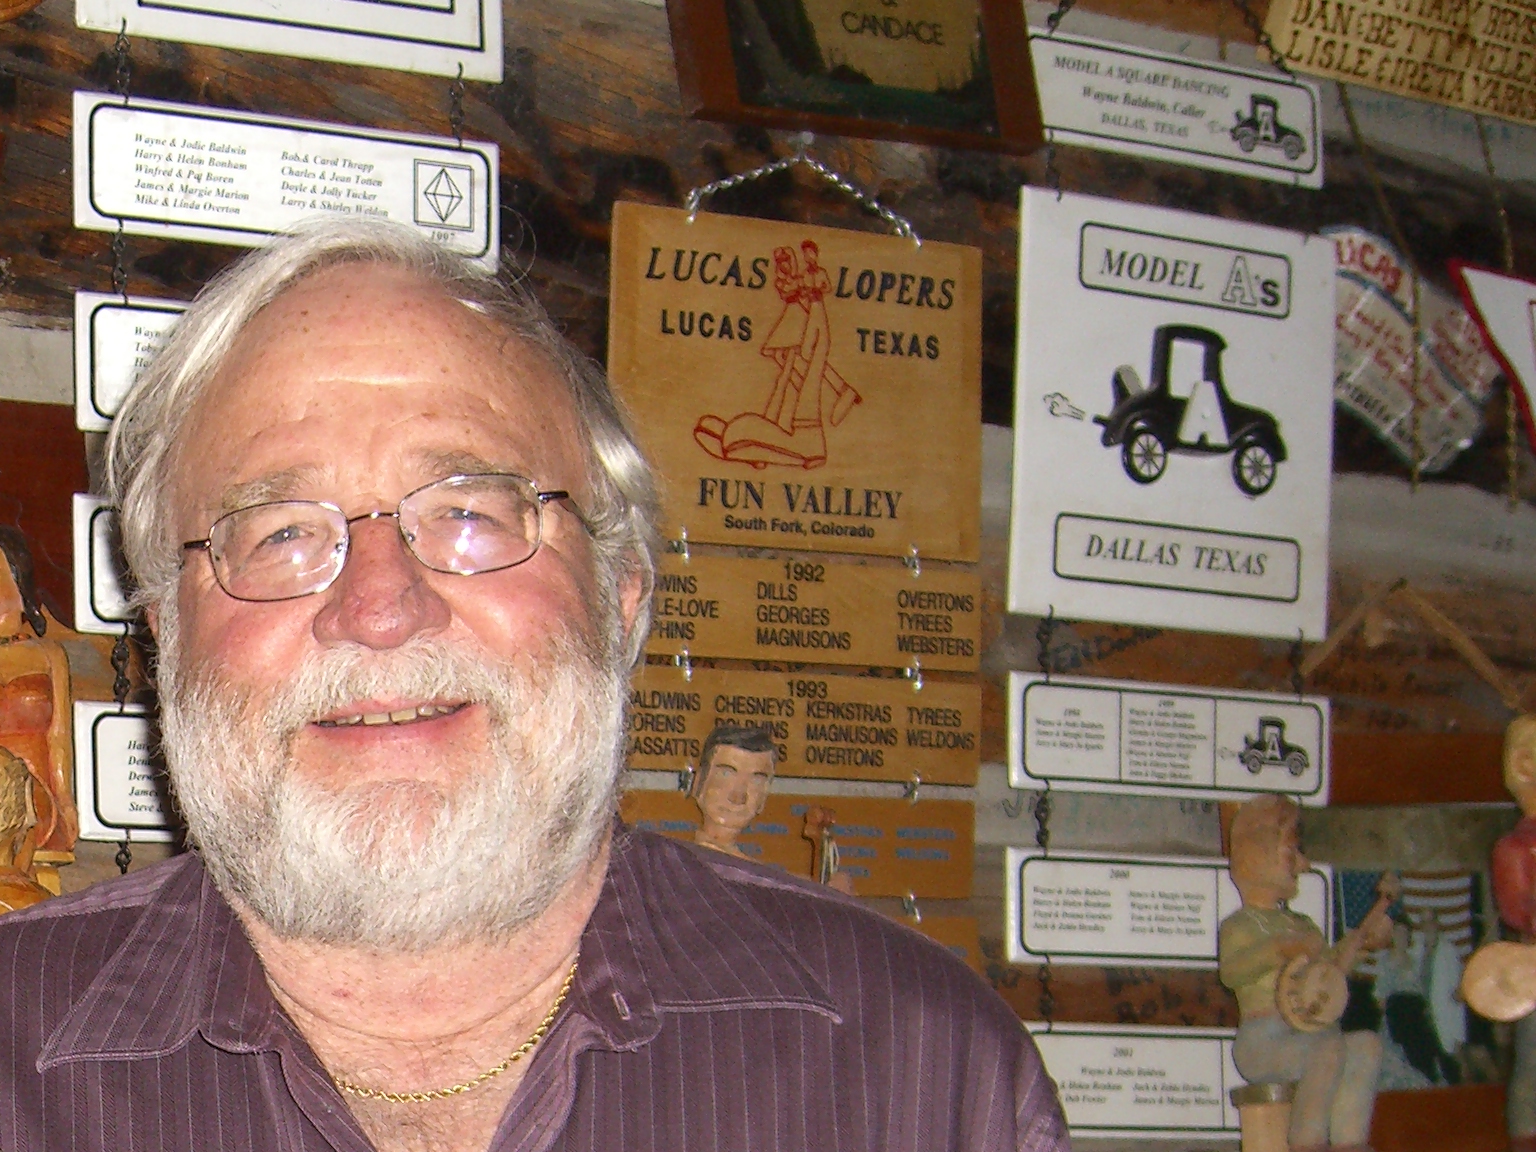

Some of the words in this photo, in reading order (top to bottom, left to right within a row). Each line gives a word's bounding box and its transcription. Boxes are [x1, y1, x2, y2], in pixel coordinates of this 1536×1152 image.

[841, 11, 944, 46] CANDACE
[1054, 55, 1100, 74] MODEL
[1106, 65, 1114, 77] A
[1118, 67, 1170, 87] SQUARE
[135, 134, 166, 145] Wayne
[209, 143, 246, 155] Baldwin
[135, 149, 161, 162] Harry
[177, 154, 204, 165] Helen
[209, 157, 247, 170] Bonham
[136, 164, 173, 177] Winfred
[135, 179, 164, 190] James
[137, 194, 158, 205] Mike
[173, 199, 200, 210] Linda
[646, 247, 770, 290] LUCAS
[835, 266, 956, 311] LOPERS
[1100, 247, 1205, 291] MODEL
[661, 309, 753, 342] LUCAS
[857, 328, 940, 360] TEXAS
[698, 477, 764, 510] FUN
[782, 483, 903, 520] VALLEY
[725, 514, 767, 531] South
[772, 517, 807, 537] Fork,
[811, 521, 875, 539] Colorado
[1085, 533, 1181, 568] DALLAS
[1192, 545, 1267, 577] TEXAS
[785, 562, 825, 583] 1992
[657, 574, 697, 594] WINS
[757, 581, 797, 601] DILLS
[655, 597, 719, 619] LE-LOVE
[898, 590, 975, 612] OVERTONS
[757, 605, 830, 626] GEORGES
[897, 613, 953, 633] TYREES
[757, 628, 851, 650] MAGNUSONS
[897, 634, 975, 656] WEBSTERS
[787, 680, 828, 700] 1993
[716, 695, 795, 717] CHESNEYS
[806, 700, 892, 723] KERKSTRAS
[906, 706, 962, 728] TYREES
[806, 724, 898, 747] MAGNUSONS
[906, 730, 975, 751] WELDONS
[806, 746, 884, 767] OVERTONS
